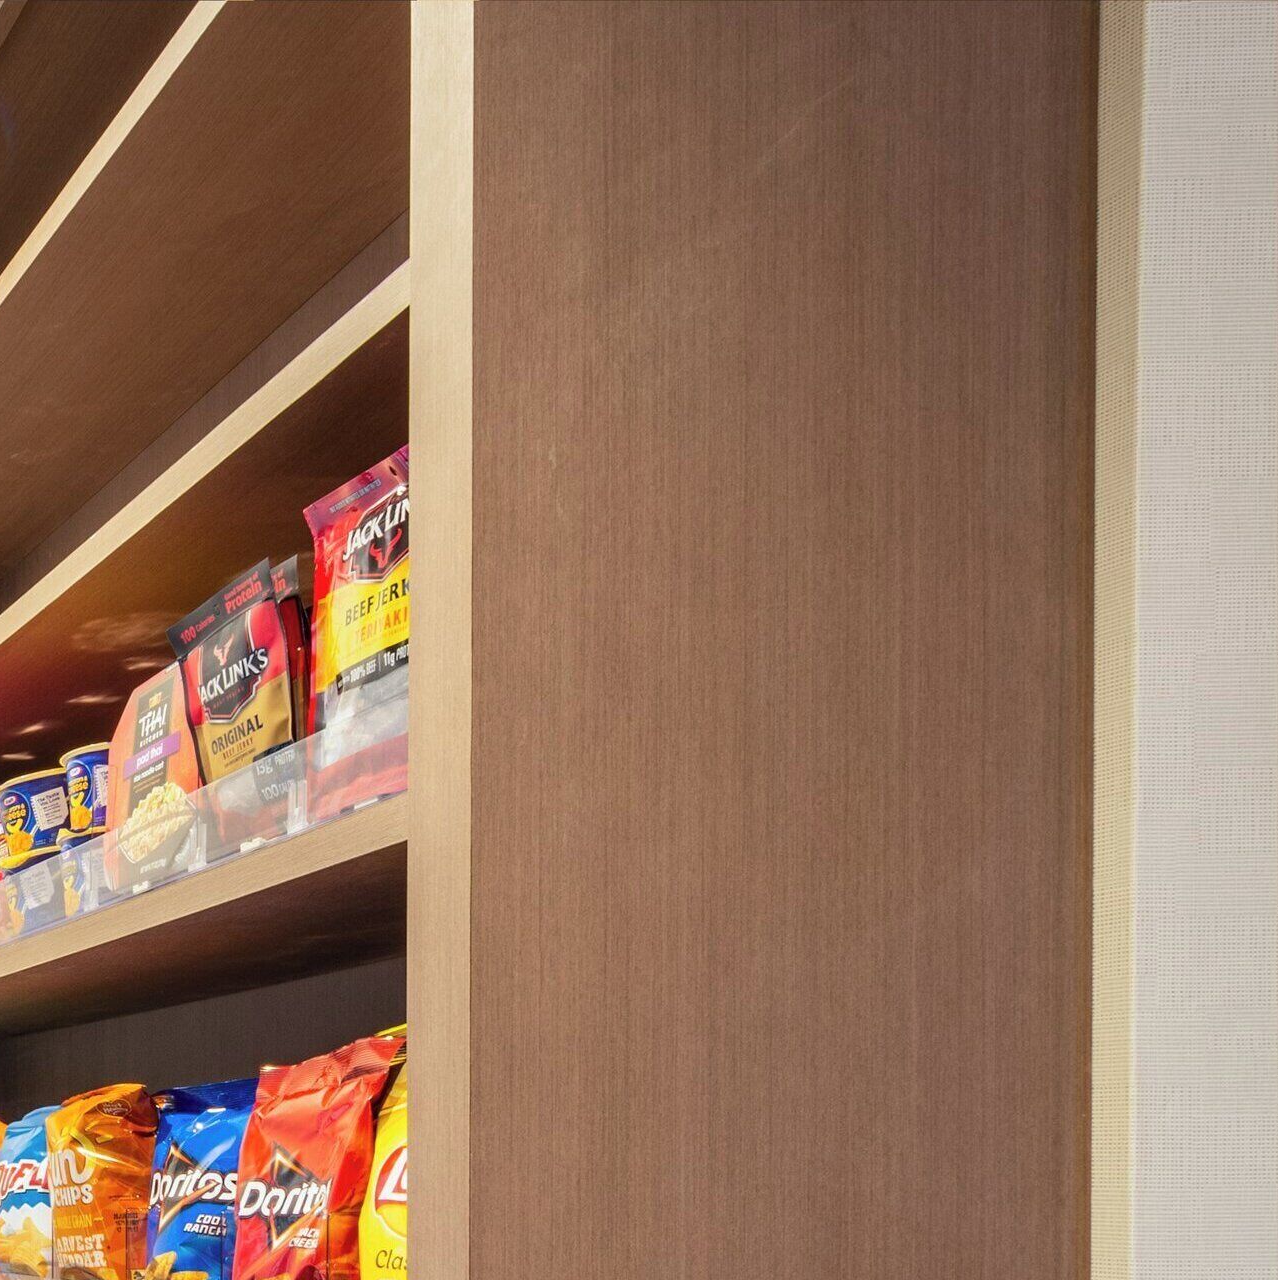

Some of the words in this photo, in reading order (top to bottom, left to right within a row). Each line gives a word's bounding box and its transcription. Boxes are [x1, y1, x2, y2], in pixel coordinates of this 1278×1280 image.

[343, 511, 385, 562] JACK
[384, 498, 409, 533] LIN
[224, 580, 263, 614] Protein
[345, 595, 374, 627] BEEF
[375, 577, 409, 612] JERK
[180, 626, 197, 644] 100
[196, 614, 216, 632] Calories
[222, 648, 269, 691] LINK'S
[138, 703, 168, 738] THAI
[210, 713, 264, 755] ORIGINAL
[54, 1183, 94, 1207] CHIPS
[148, 1170, 238, 1209] Doritos
[183, 1223, 228, 1237] RANCH
[195, 1213, 228, 1226] COOL
[56, 1233, 105, 1253] ARVEST
[56, 1250, 107, 1269] HEDDAR
